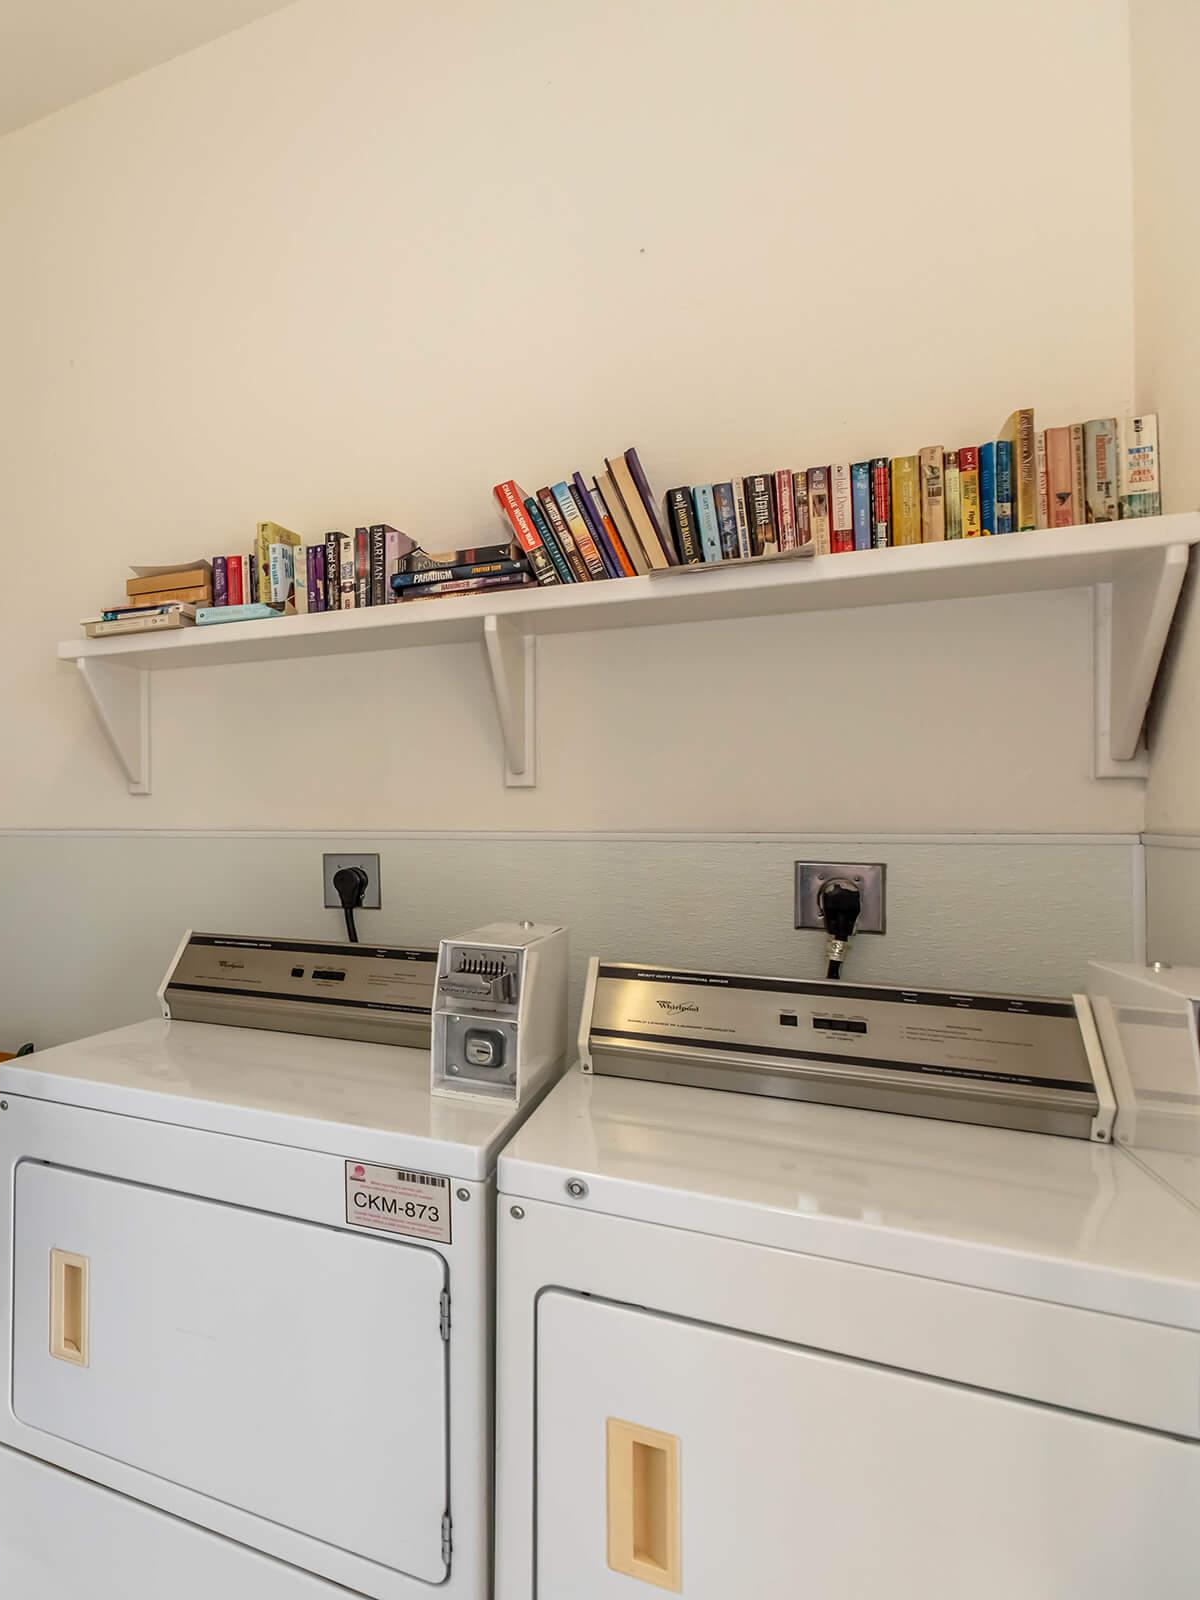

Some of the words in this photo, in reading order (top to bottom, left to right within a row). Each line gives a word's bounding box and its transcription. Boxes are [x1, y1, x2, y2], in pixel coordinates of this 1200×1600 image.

[836, 477, 848, 494] Jude
[501, 483, 517, 509] CHARLIE
[513, 505, 530, 536] WILSON'S
[524, 532, 537, 547] WAR
[677, 508, 687, 528] DAVID
[754, 491, 769, 526] VERITAS
[327, 541, 336, 563] Daniel
[681, 527, 693, 556] BALDACCI
[374, 532, 383, 580] MARTIAN
[327, 563, 335, 579] Silva
[413, 570, 453, 583] PARADIGM
[658, 1001, 699, 1013] Whirlpool
[353, 1192, 440, 1222] CKM-873
